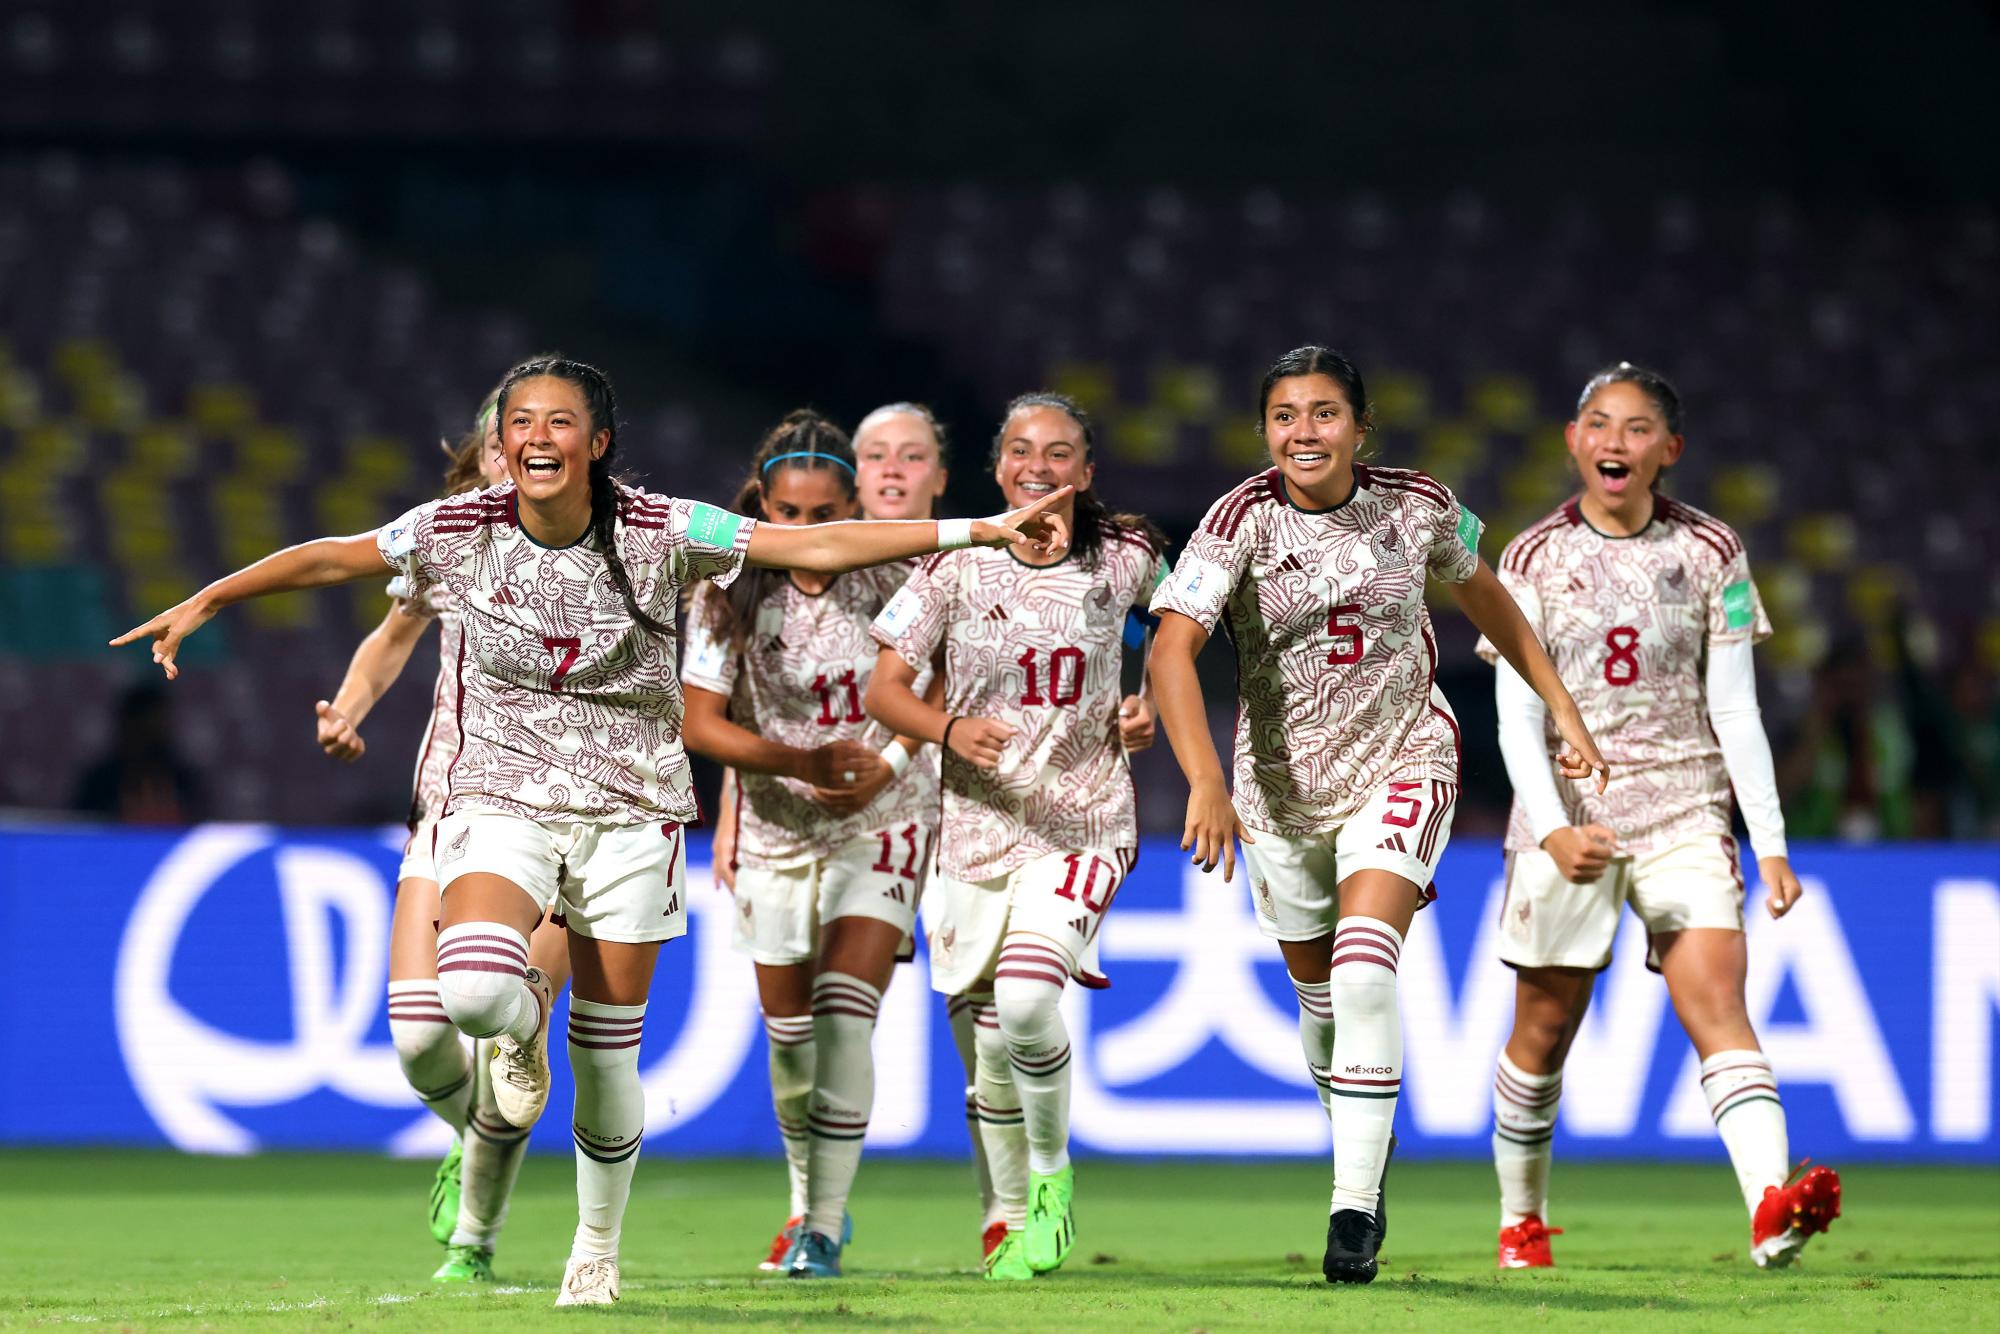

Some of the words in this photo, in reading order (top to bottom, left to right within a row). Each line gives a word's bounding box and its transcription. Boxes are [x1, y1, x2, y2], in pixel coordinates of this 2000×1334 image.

[1327, 604, 1364, 665] 5
[1604, 626, 1640, 687] 8
[543, 637, 581, 692] 7
[1018, 646, 1085, 707] 10
[812, 669, 865, 727] 11
[1382, 782, 1422, 828] 5
[661, 821, 681, 888] 7
[872, 823, 917, 880] 11
[1055, 853, 1117, 914] 10
[1345, 1065, 1393, 1074] MÉXICO
